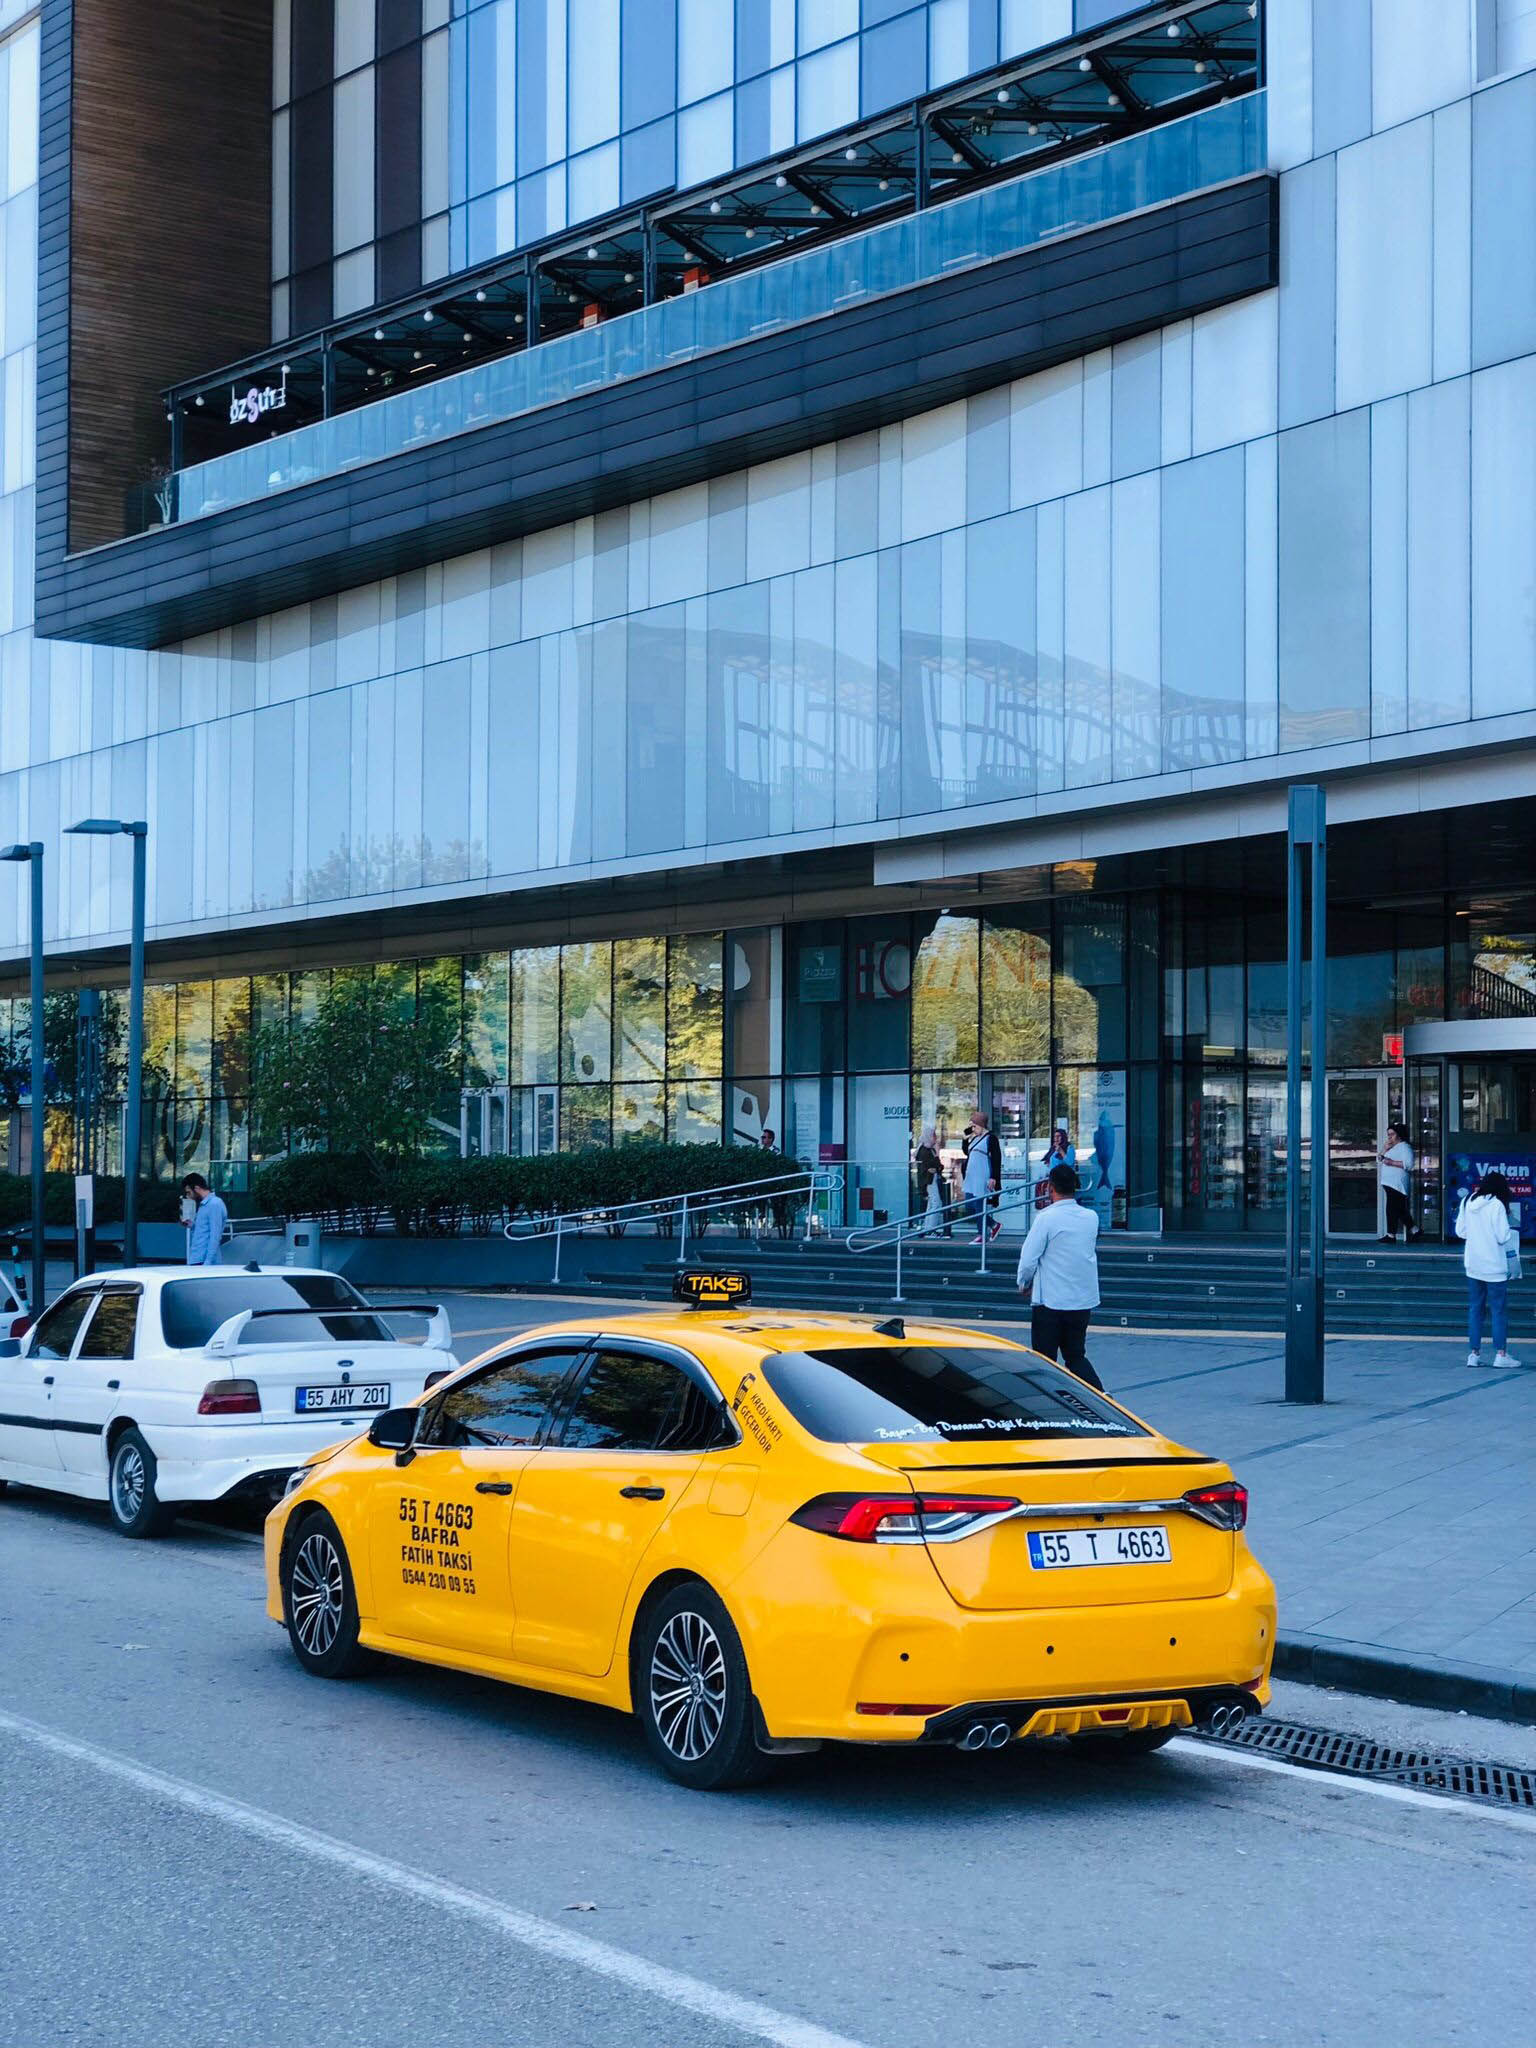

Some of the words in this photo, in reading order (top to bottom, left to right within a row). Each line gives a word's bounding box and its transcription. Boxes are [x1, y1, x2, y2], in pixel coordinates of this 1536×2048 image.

[308, 1390, 324, 1406] 55
[330, 1389, 354, 1406] AHY
[363, 1387, 385, 1404] 201
[399, 1497, 417, 1522] 55
[423, 1500, 430, 1524] T
[435, 1502, 473, 1530] 4663
[411, 1525, 459, 1547] BAFRA
[1032, 1553, 1043, 1562] TR
[1043, 1535, 1070, 1563] 55
[1086, 1533, 1098, 1561] T
[1117, 1531, 1165, 1559] 4663
[402, 1544, 434, 1566] FATİH
[437, 1551, 473, 1571] TAKSİ
[402, 1568, 426, 1586] 0544
[428, 1572, 446, 1590] 230
[448, 1575, 461, 1592] 09
[463, 1578, 476, 1595] 55
